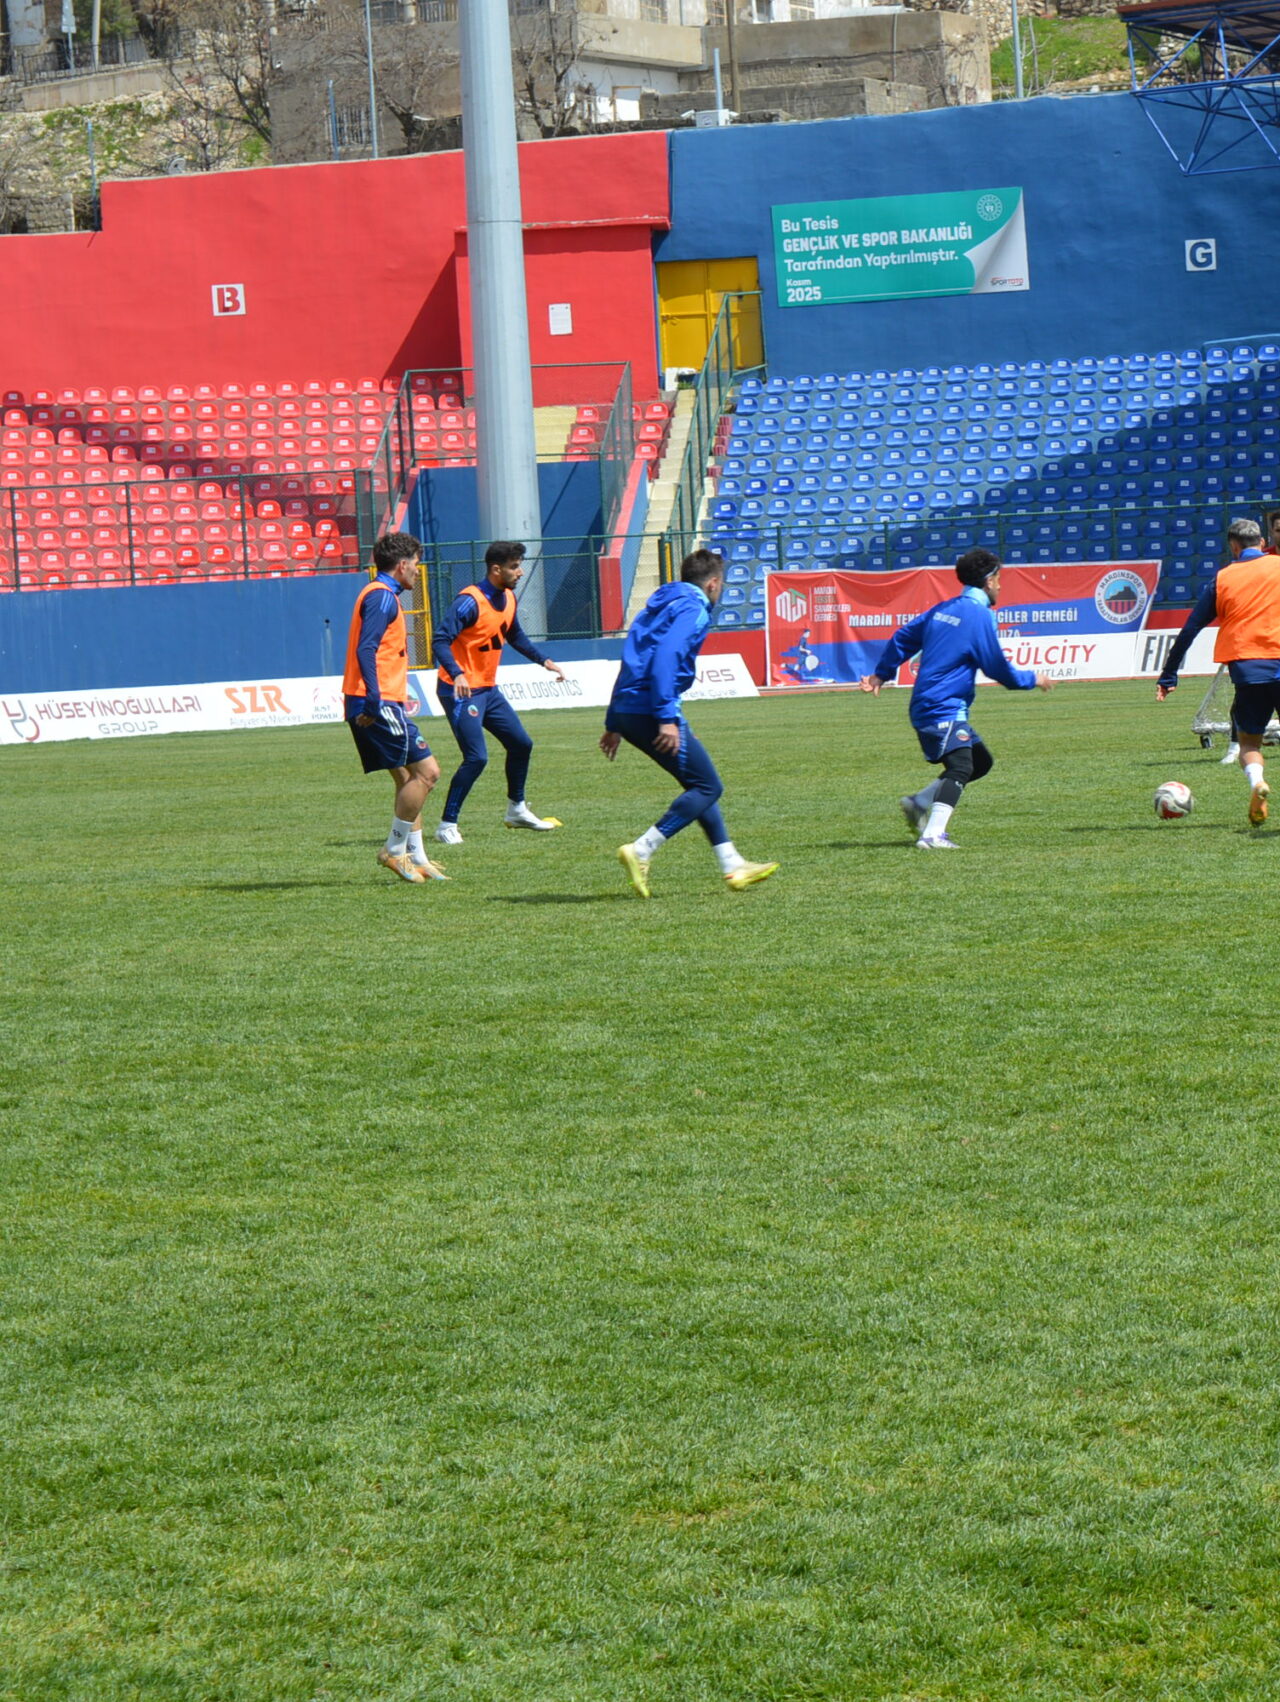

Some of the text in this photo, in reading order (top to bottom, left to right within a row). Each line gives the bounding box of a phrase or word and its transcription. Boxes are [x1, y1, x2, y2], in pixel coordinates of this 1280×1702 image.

[781, 215, 839, 232] Bu Tesis
[841, 234, 860, 249] VE
[862, 231, 898, 247] SPOR
[901, 222, 972, 244] BAKANLIĞI
[784, 248, 958, 272] Tarafından Yaptırılmıştır.
[1189, 241, 1213, 268] G
[786, 278, 812, 287] Kasım
[787, 286, 822, 302] 2025
[216, 287, 241, 313] B
[848, 612, 892, 627] MARDİN
[1031, 607, 1079, 623] DERNEĞİ
[1002, 639, 1096, 666] GÜLCİTY
[224, 685, 291, 714] SZR
[526, 679, 583, 699] LOGISTICS
[35, 695, 203, 721] HÜSEYİNOĞULLARI
[98, 720, 158, 735] GROUP
